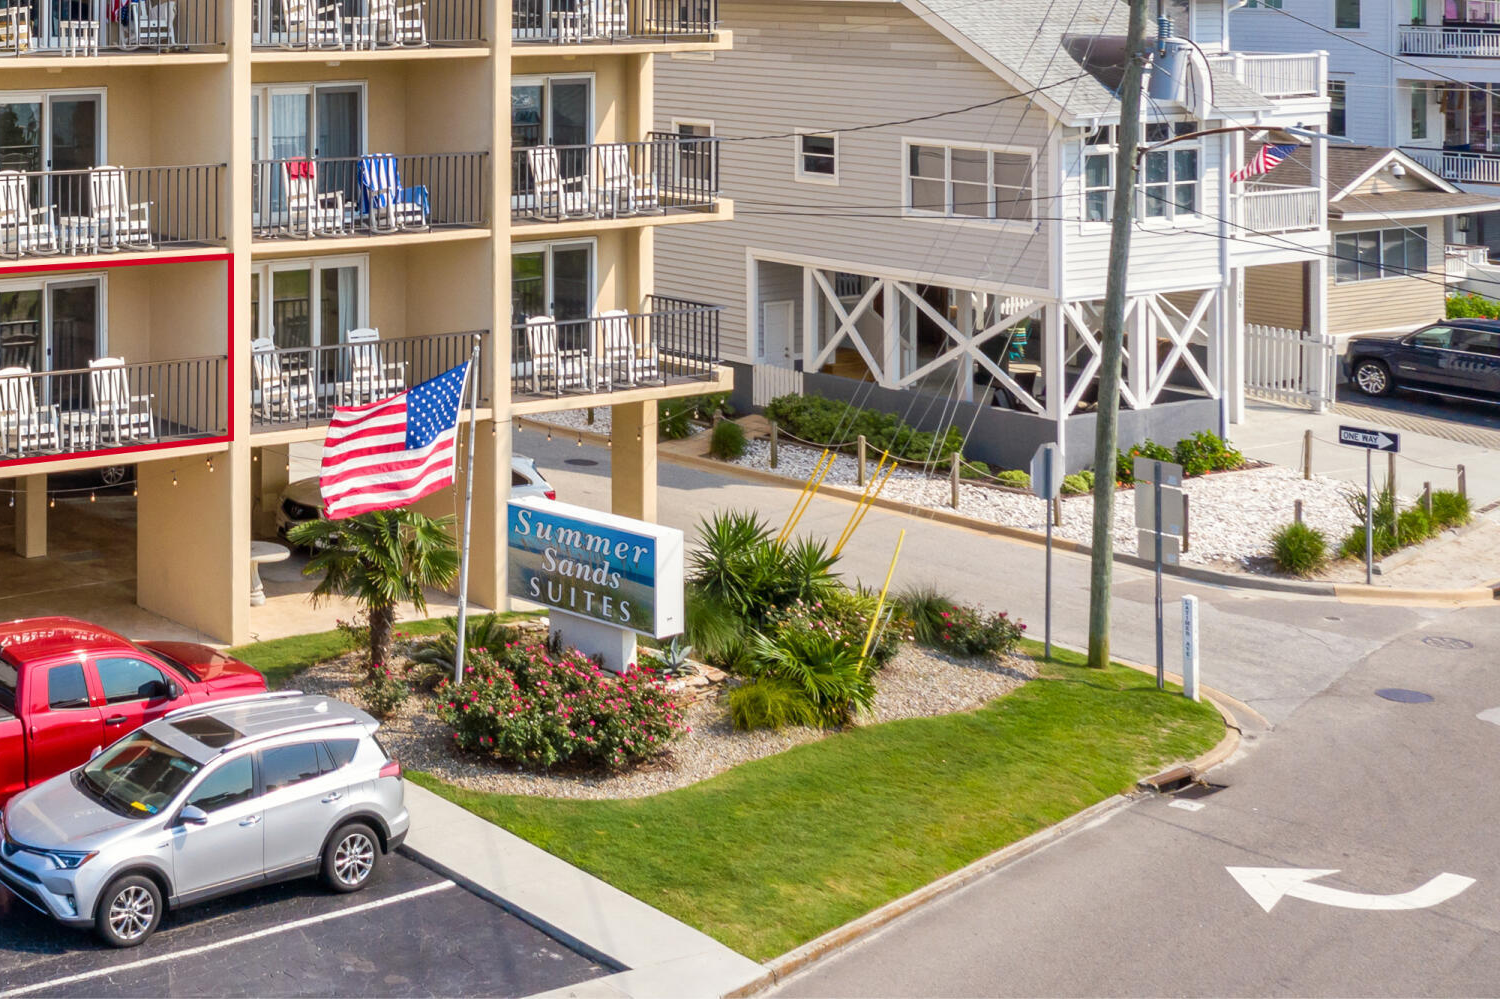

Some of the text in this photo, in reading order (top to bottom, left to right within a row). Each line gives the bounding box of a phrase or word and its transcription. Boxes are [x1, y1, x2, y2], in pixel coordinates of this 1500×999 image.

[1343, 431, 1379, 443] ONE WAY
[514, 509, 648, 564] Summer
[541, 547, 621, 590] Sands
[530, 577, 631, 622] SUITES
